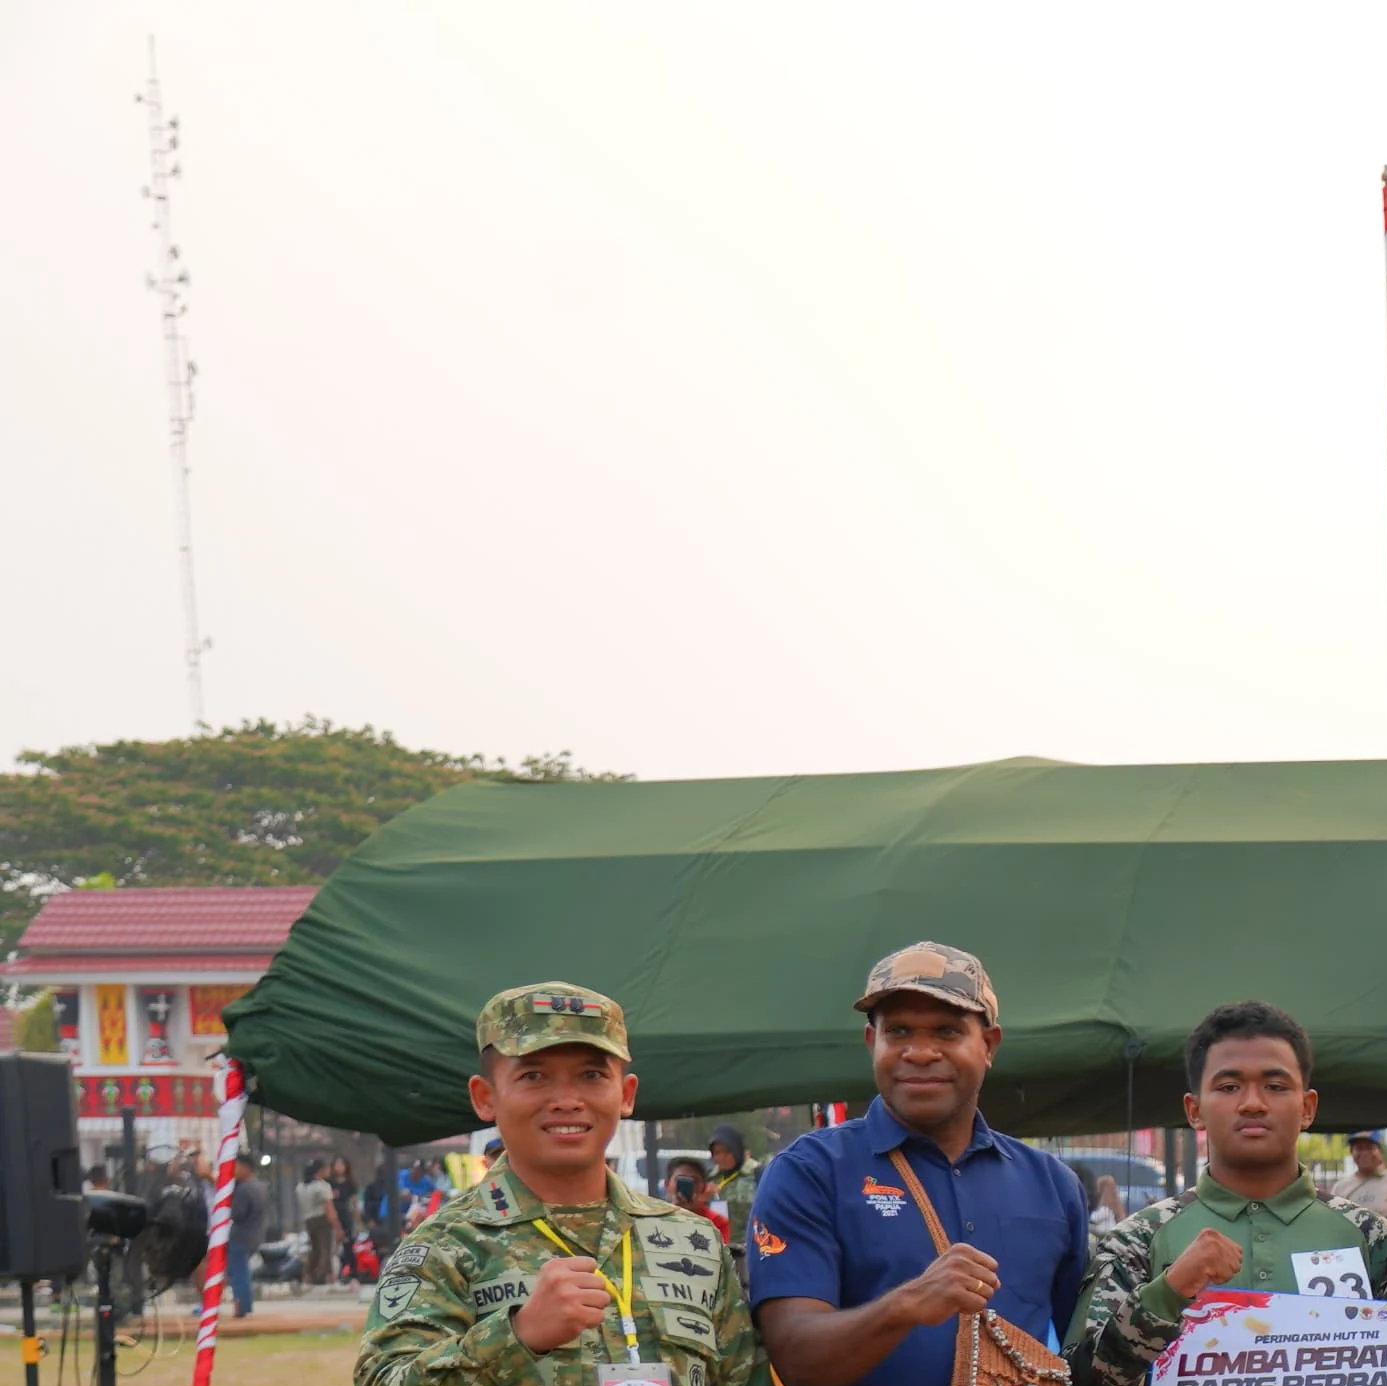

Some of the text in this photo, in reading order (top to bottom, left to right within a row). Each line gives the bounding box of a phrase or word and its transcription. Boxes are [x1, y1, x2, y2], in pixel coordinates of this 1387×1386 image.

[657, 1283, 693, 1301] TNI
[1307, 1272, 1368, 1299] 23
[1255, 1330, 1380, 1344] PERINGATAN HUT TNI
[1178, 1349, 1289, 1377] LOMBA
